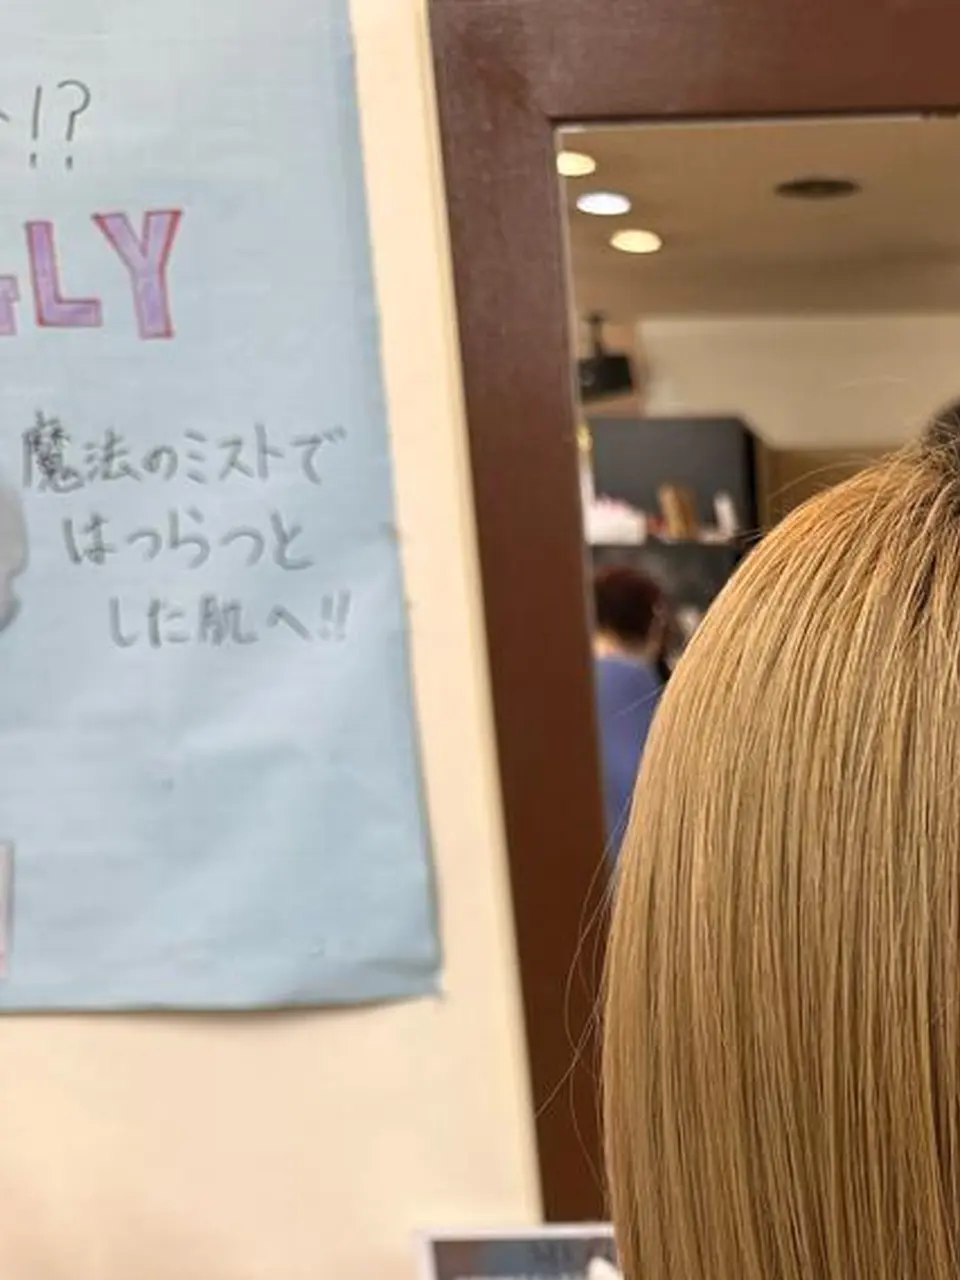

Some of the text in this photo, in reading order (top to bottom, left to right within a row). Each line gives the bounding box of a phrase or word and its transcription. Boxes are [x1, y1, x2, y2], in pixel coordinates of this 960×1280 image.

[22, 410, 347, 493] 魔法のミストで
[62, 505, 315, 571] はつらつと
